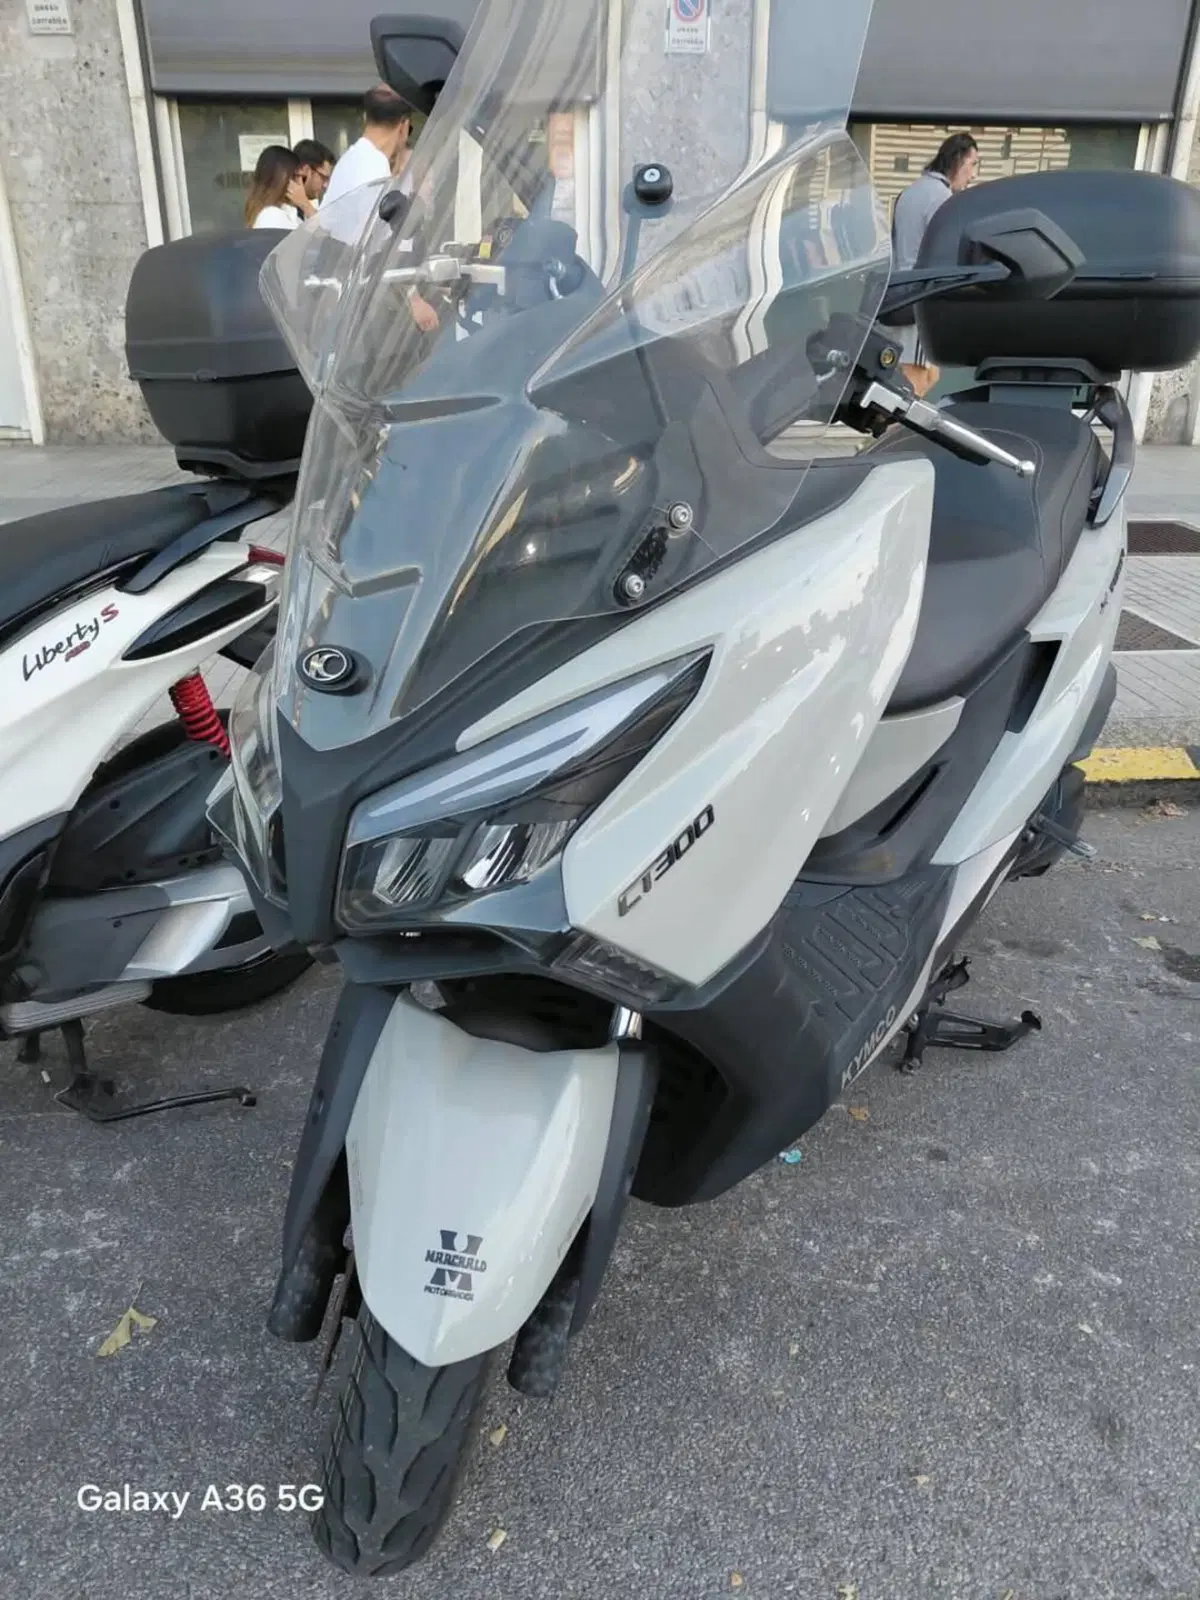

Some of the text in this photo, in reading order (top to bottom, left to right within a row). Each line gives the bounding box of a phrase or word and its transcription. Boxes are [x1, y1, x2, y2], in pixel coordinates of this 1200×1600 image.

[22, 617, 100, 681] Liberty
[617, 803, 715, 917] CT300
[841, 1004, 896, 1089] KYMCO
